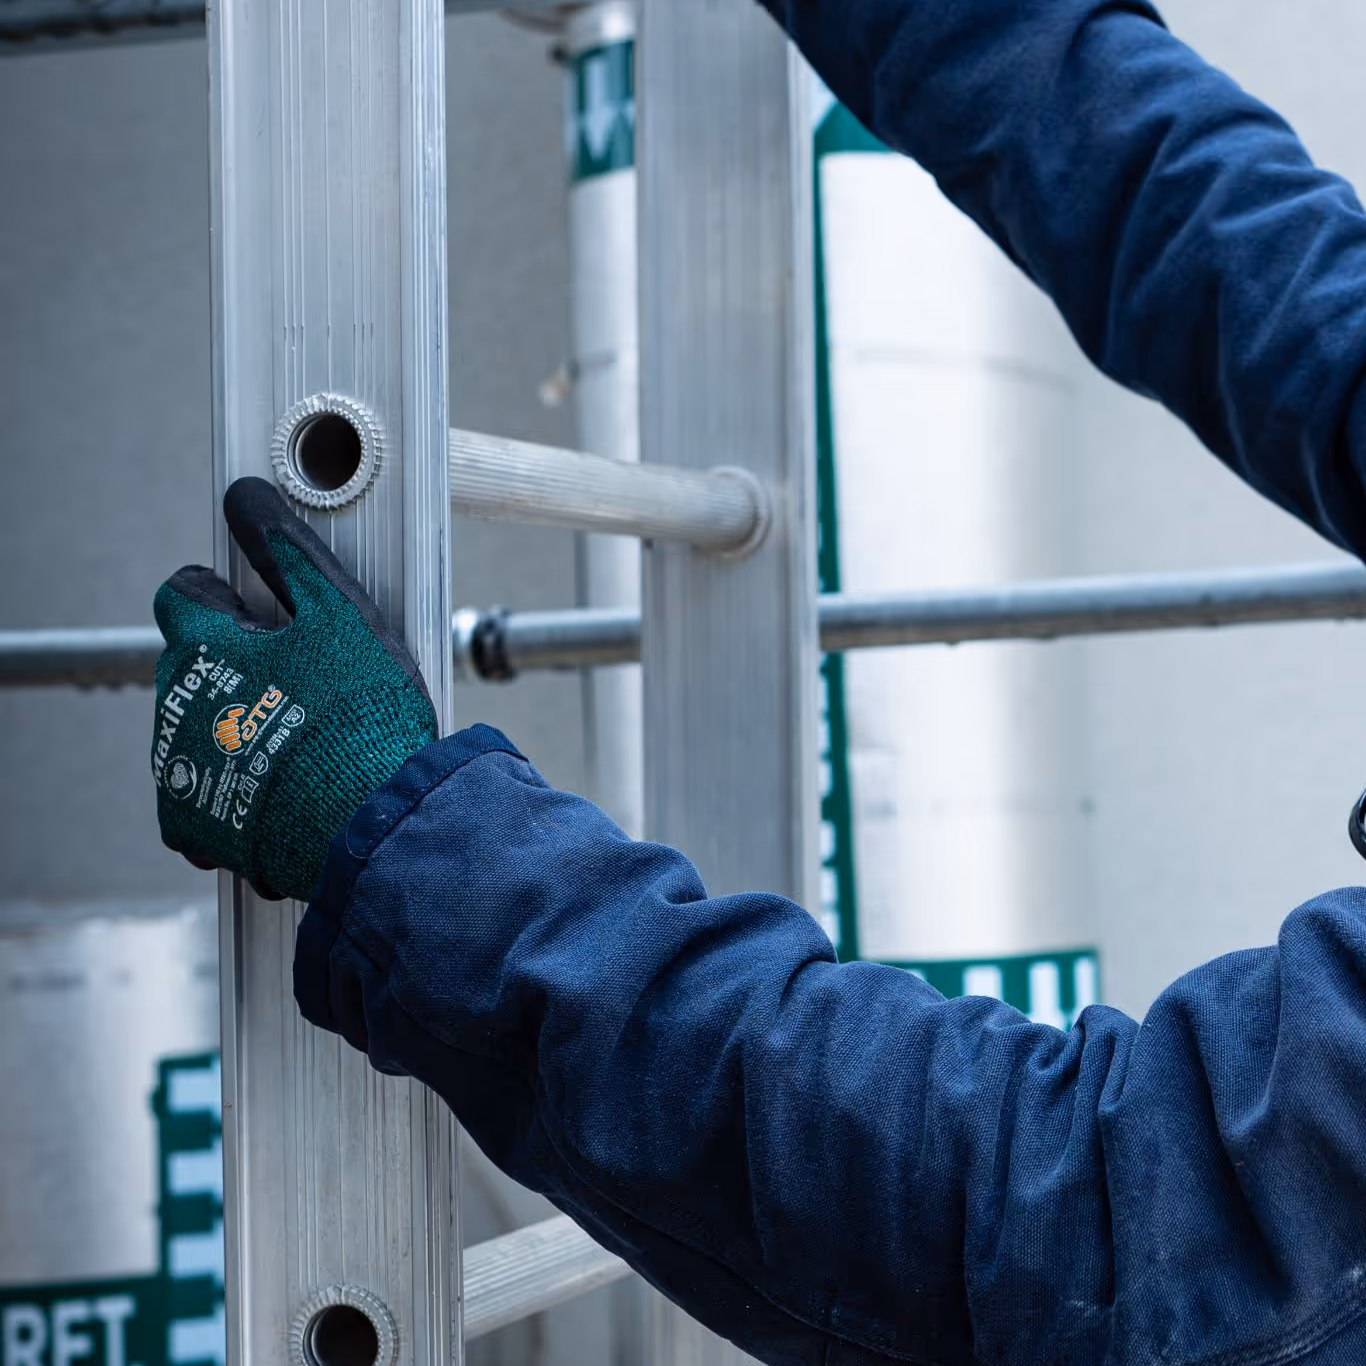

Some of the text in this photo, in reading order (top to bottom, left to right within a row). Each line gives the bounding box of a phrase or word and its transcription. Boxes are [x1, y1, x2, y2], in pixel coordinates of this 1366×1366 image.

[207, 668, 234, 700] 34-8743
[223, 673, 244, 695] 8(M)
[290, 712, 301, 723] A2
[267, 727, 291, 755] 4331B
